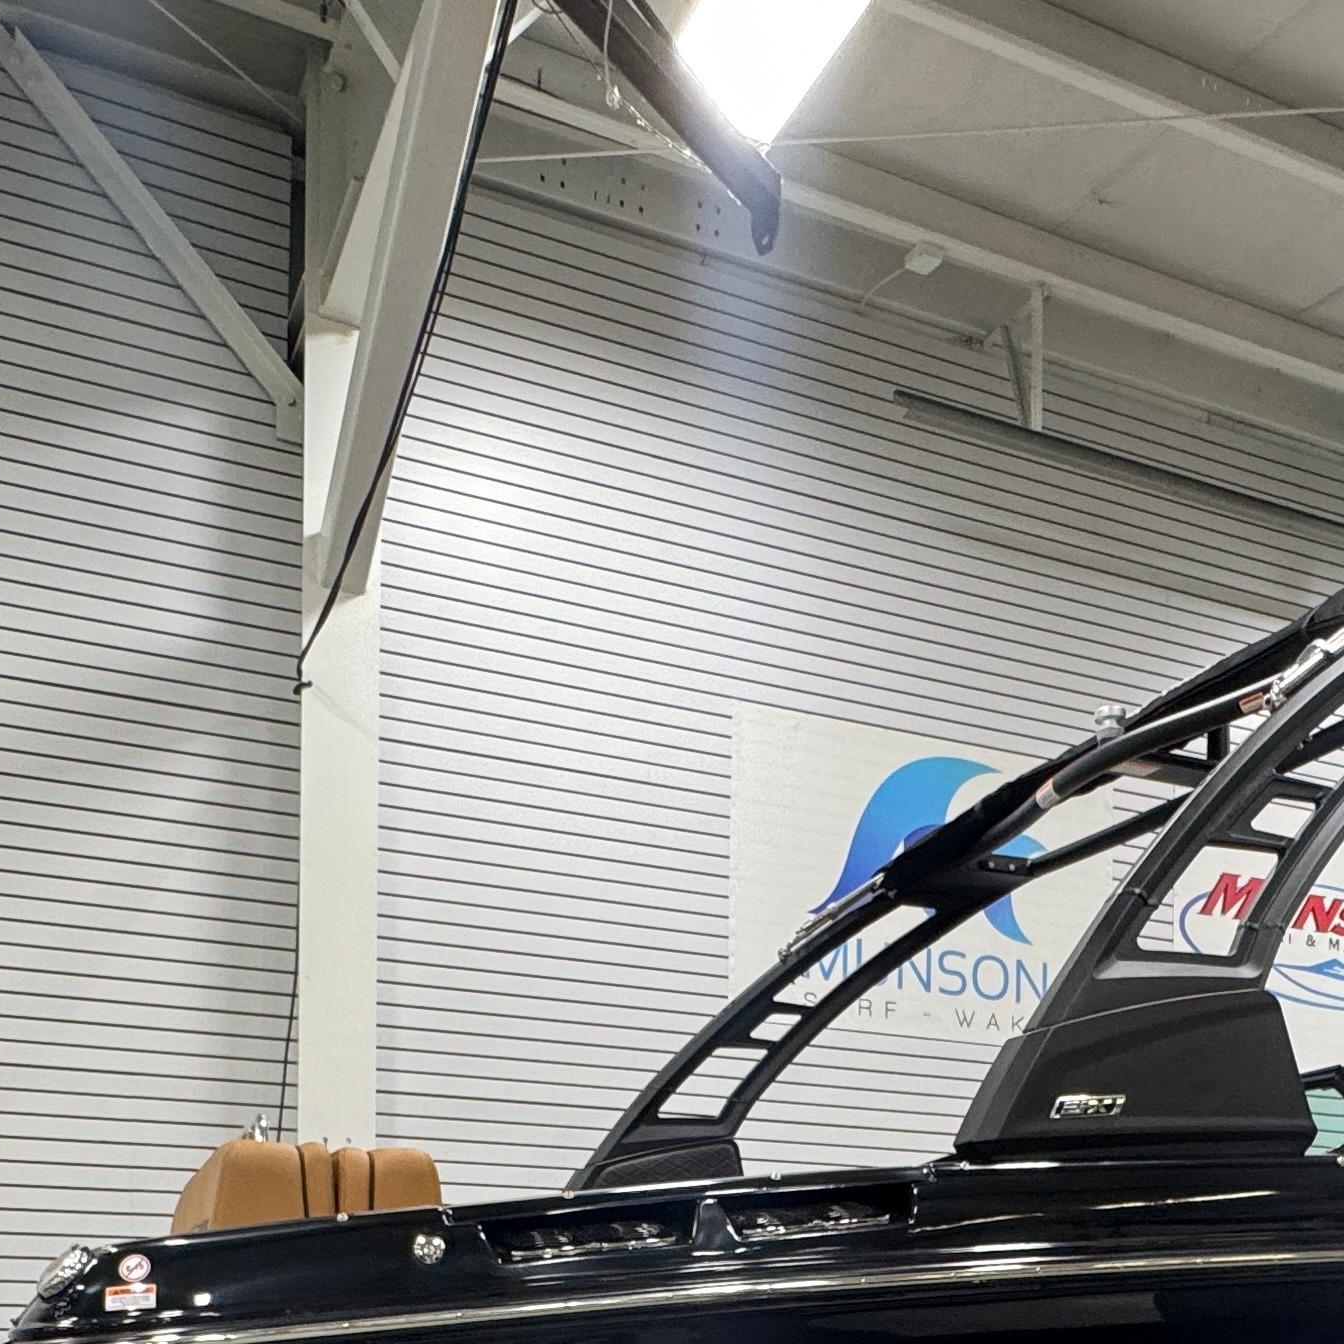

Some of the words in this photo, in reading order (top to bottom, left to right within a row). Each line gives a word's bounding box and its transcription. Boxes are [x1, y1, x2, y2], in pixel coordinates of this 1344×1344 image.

[1306, 934, 1316, 947] &
[803, 992, 897, 1019] SRF
[955, 1008, 1025, 1032] WAK
